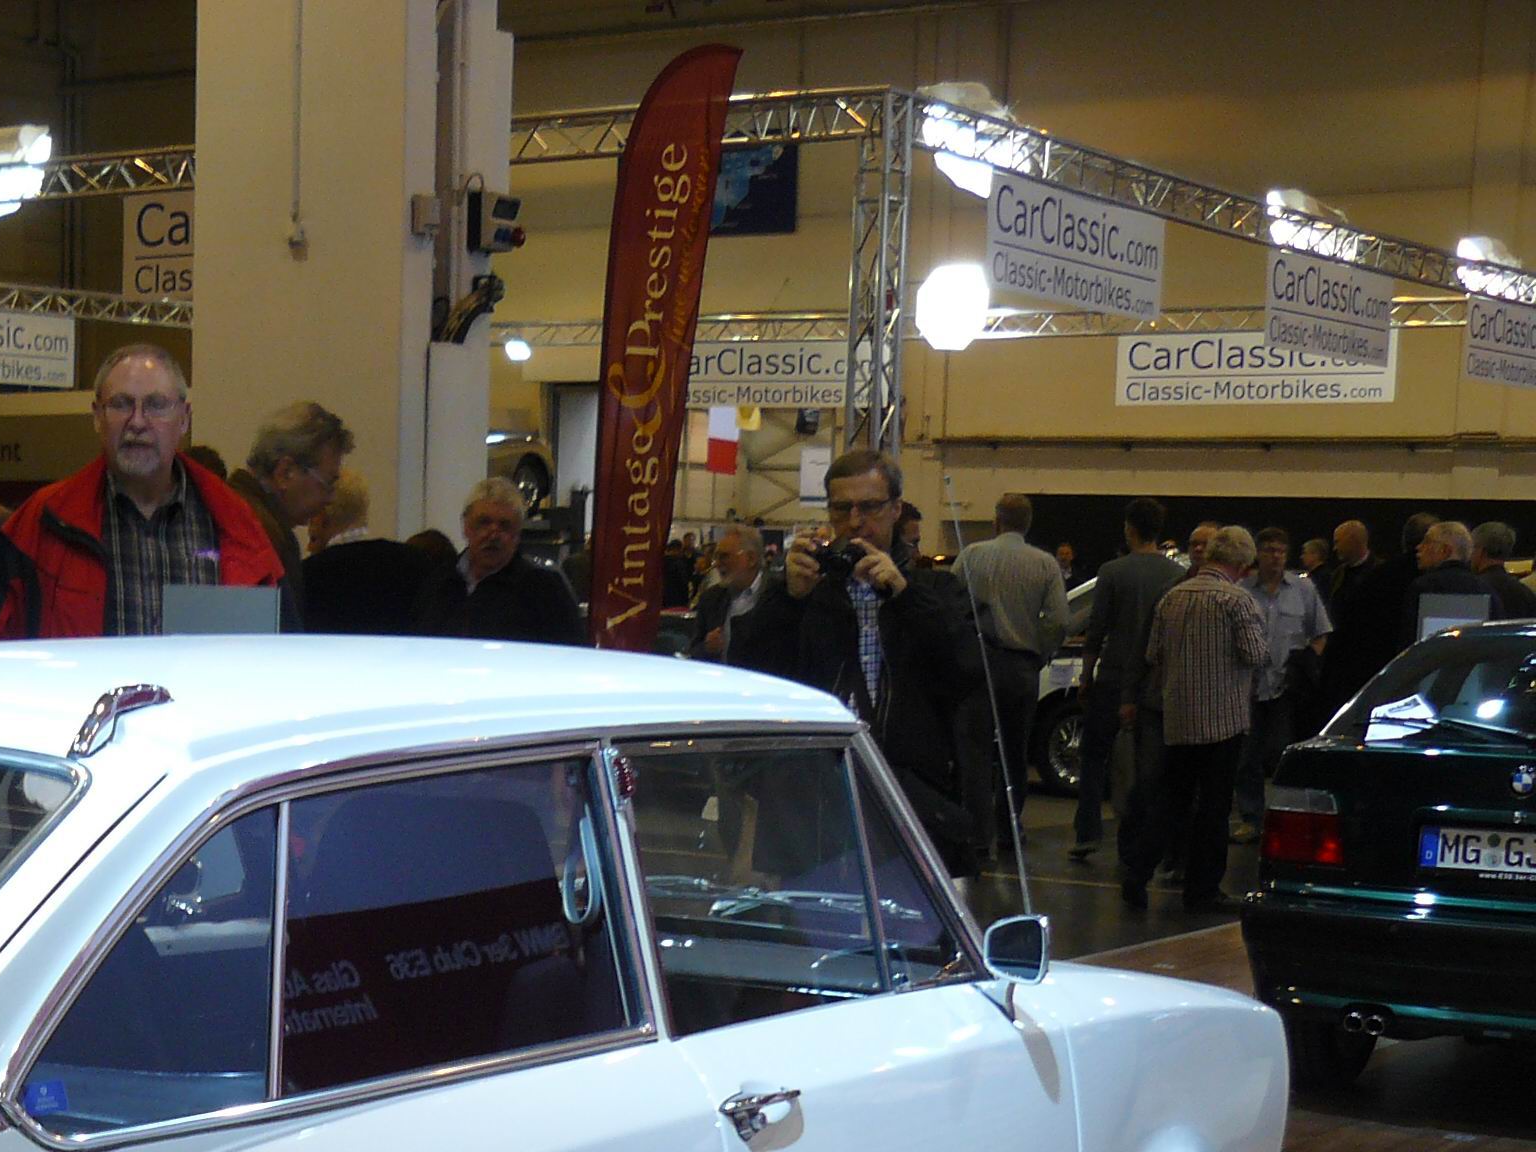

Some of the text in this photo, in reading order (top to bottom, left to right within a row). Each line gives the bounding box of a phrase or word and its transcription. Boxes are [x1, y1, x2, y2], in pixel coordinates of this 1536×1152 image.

[136, 202, 190, 247] Ca
[996, 184, 1159, 271] CarClassic.com
[135, 263, 192, 294] Clas
[992, 251, 1155, 315] Classic-Motorbikes.com
[1272, 258, 1389, 323] CarClassic.com
[1470, 303, 1536, 350] CarClassic
[606, 143, 692, 633] Vintage & Prestige
[1125, 378, 1383, 402] Classic-Motorbikes.com
[1439, 833, 1482, 865] MG
